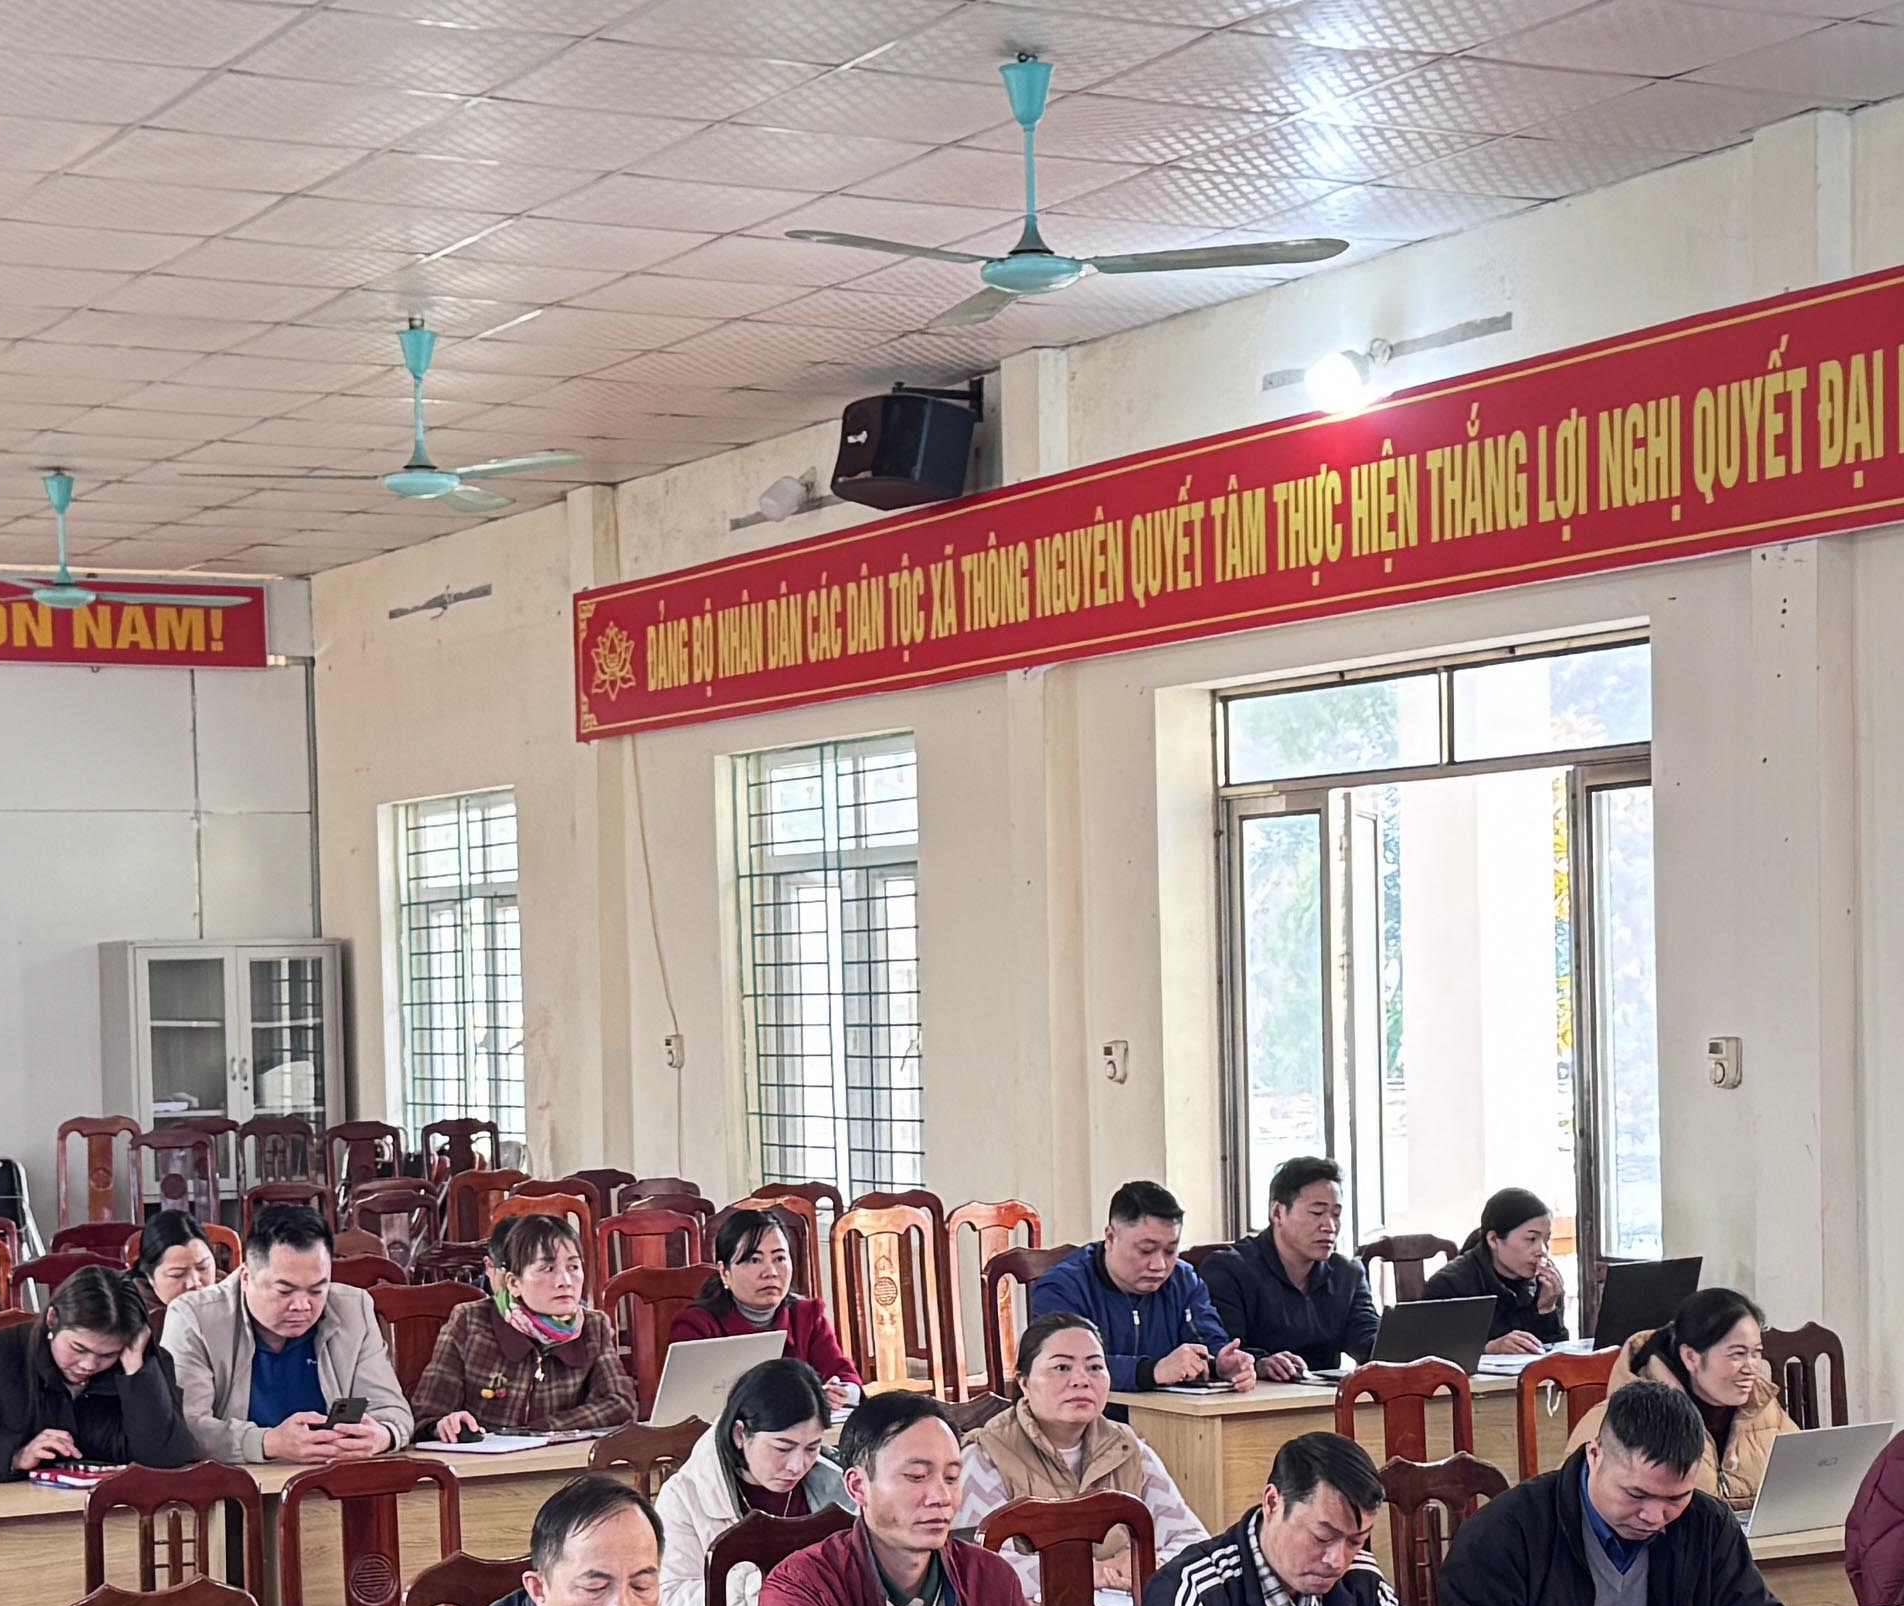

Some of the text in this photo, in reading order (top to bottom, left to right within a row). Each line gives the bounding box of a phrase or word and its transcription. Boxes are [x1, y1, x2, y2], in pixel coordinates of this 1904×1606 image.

[646, 600, 688, 692] ĐẢNG
[692, 598, 714, 697] BỘ
[717, 589, 763, 679] NHÂN
[767, 581, 802, 670] DÂN
[807, 572, 842, 662] CÁC
[846, 563, 884, 655] DÂN
[888, 553, 925, 662] TỘC
[929, 543, 958, 640] XÃ
[961, 531, 1029, 632] THÔNG
[1035, 505, 1124, 618] NGUYÊN
[1129, 473, 1205, 608] QUYẾT
[1211, 474, 1267, 584] TÂM
[1273, 463, 1342, 587] THỰC
[1351, 438, 1418, 573] HIỆN
[1426, 401, 1528, 543] THẮNG
[1538, 407, 1587, 541] LỢI
[1598, 394, 1681, 521] NGHỊ
[1694, 333, 1807, 505] QUYẾT
[1818, 349, 1884, 488] ĐẠI
